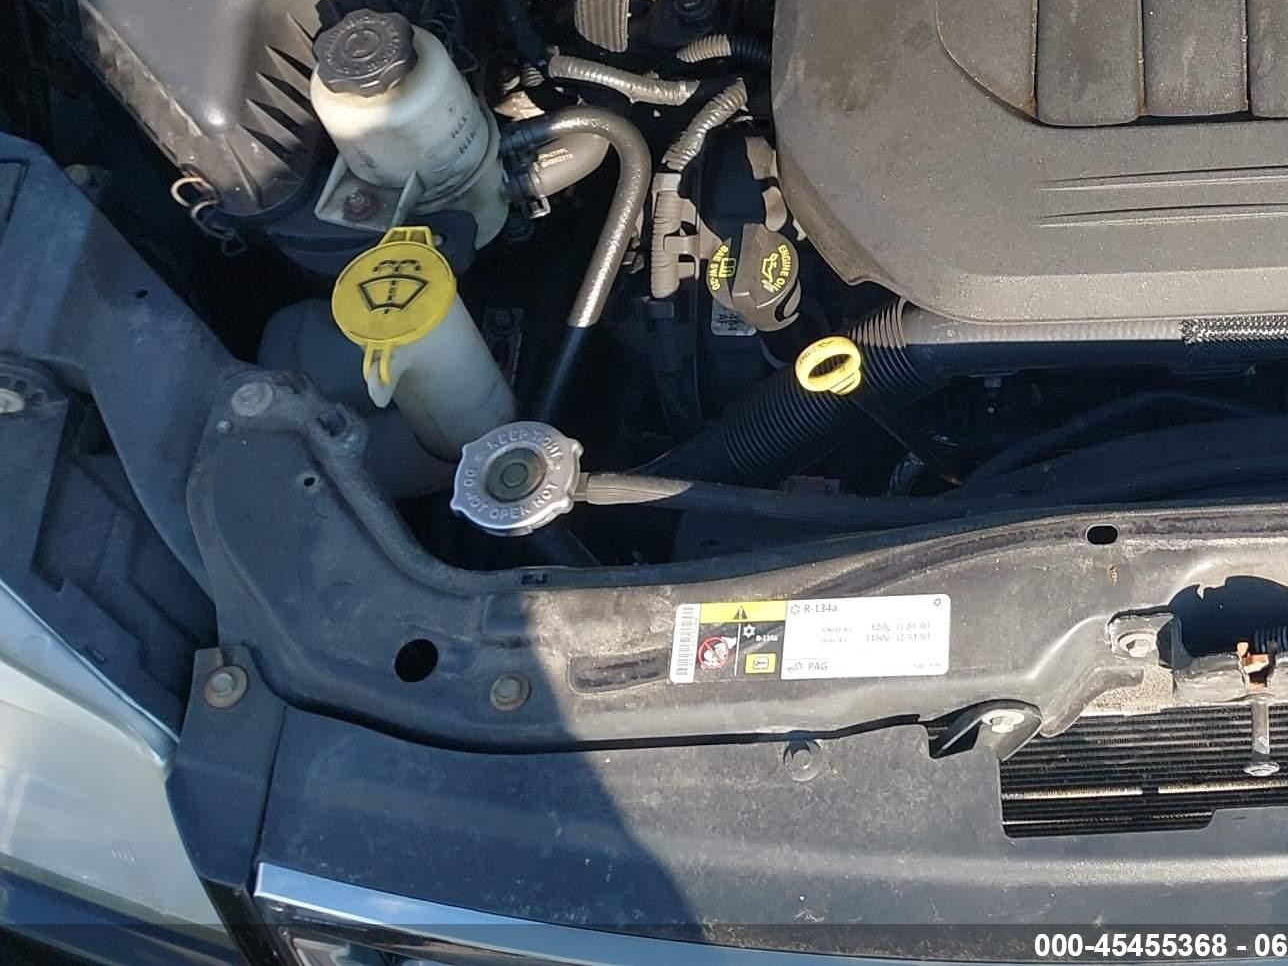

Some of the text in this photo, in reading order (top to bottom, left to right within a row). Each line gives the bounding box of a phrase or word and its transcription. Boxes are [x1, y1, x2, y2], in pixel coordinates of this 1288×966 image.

[708, 245, 729, 291] SAE 5W-20
[772, 244, 792, 292] ENGINE OIL
[486, 429, 529, 451] KEEP
[463, 468, 560, 520] DO NOT OPEN HOT
[803, 603, 839, 614] R-134a
[807, 661, 829, 672] PAG
